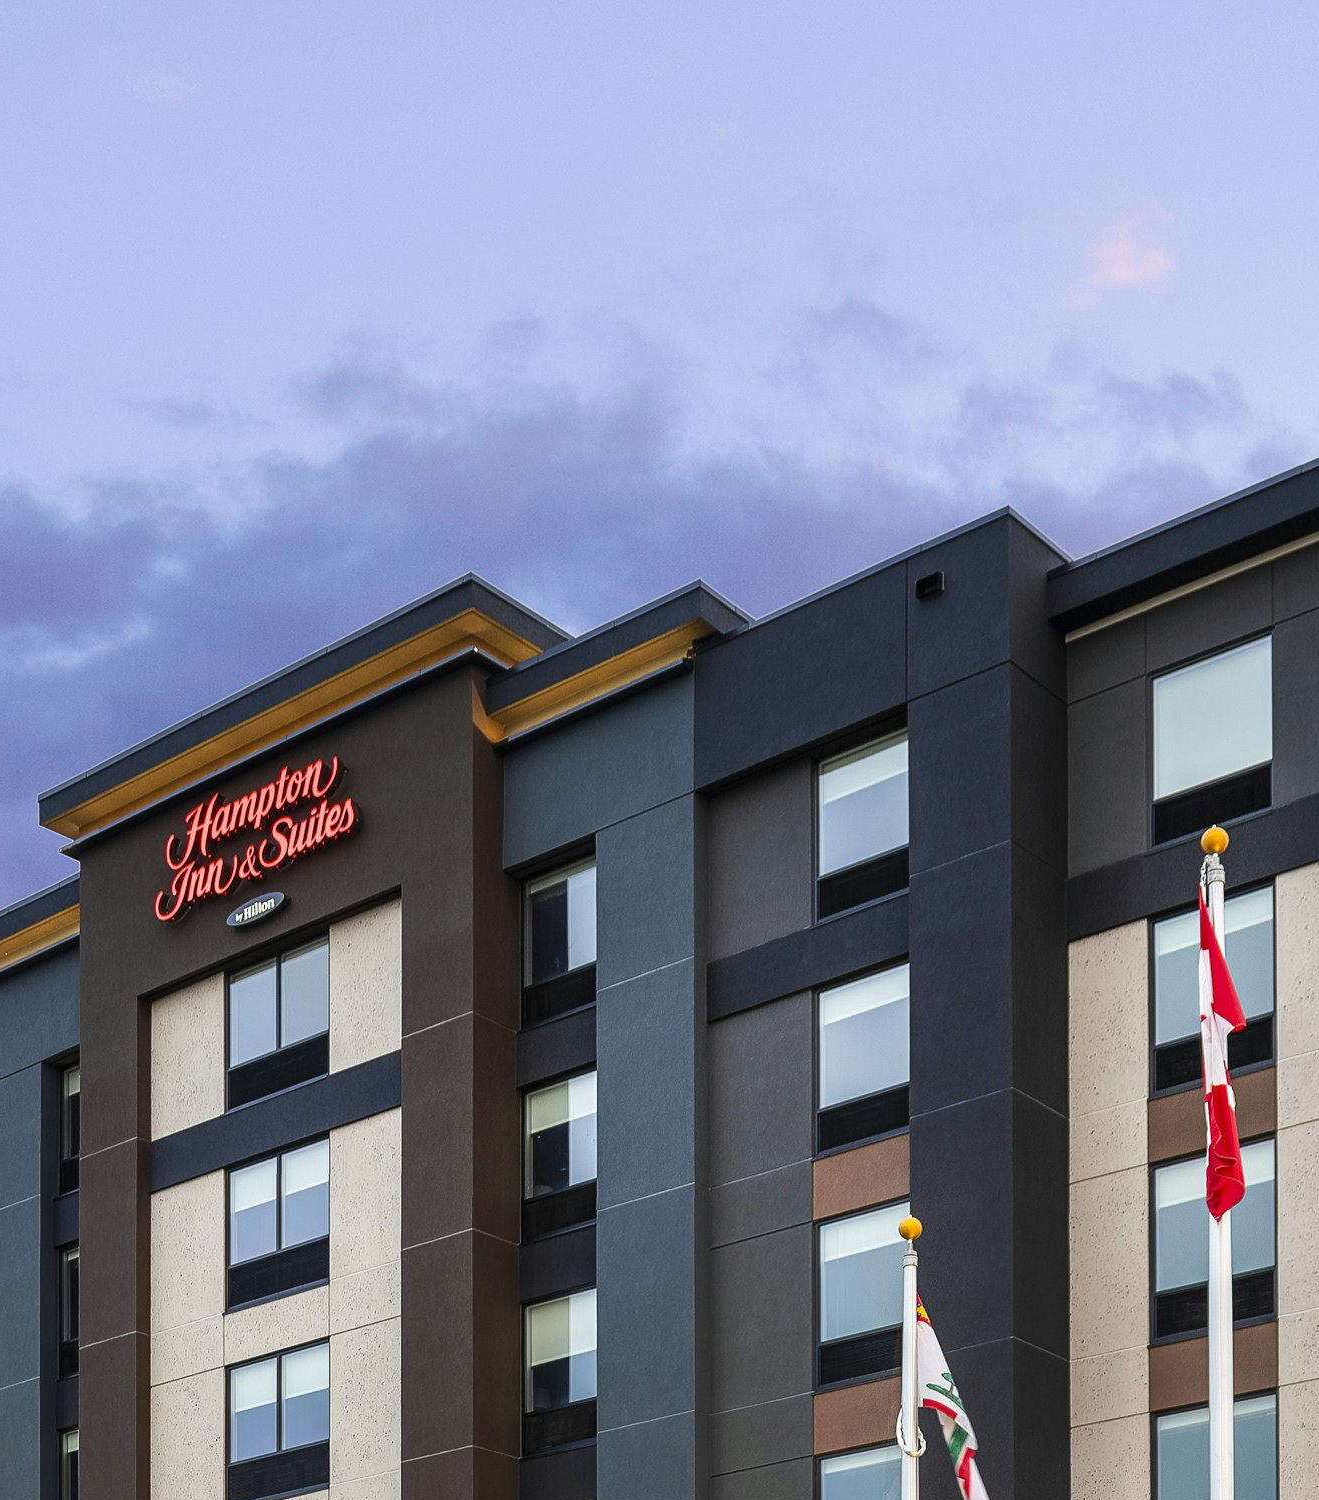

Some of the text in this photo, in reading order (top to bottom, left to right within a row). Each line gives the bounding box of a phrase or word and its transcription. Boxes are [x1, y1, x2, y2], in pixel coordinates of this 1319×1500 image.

[155, 798, 355, 921] Inn & Suites
[166, 755, 338, 870] Hampton
[243, 898, 275, 921] Hilton
